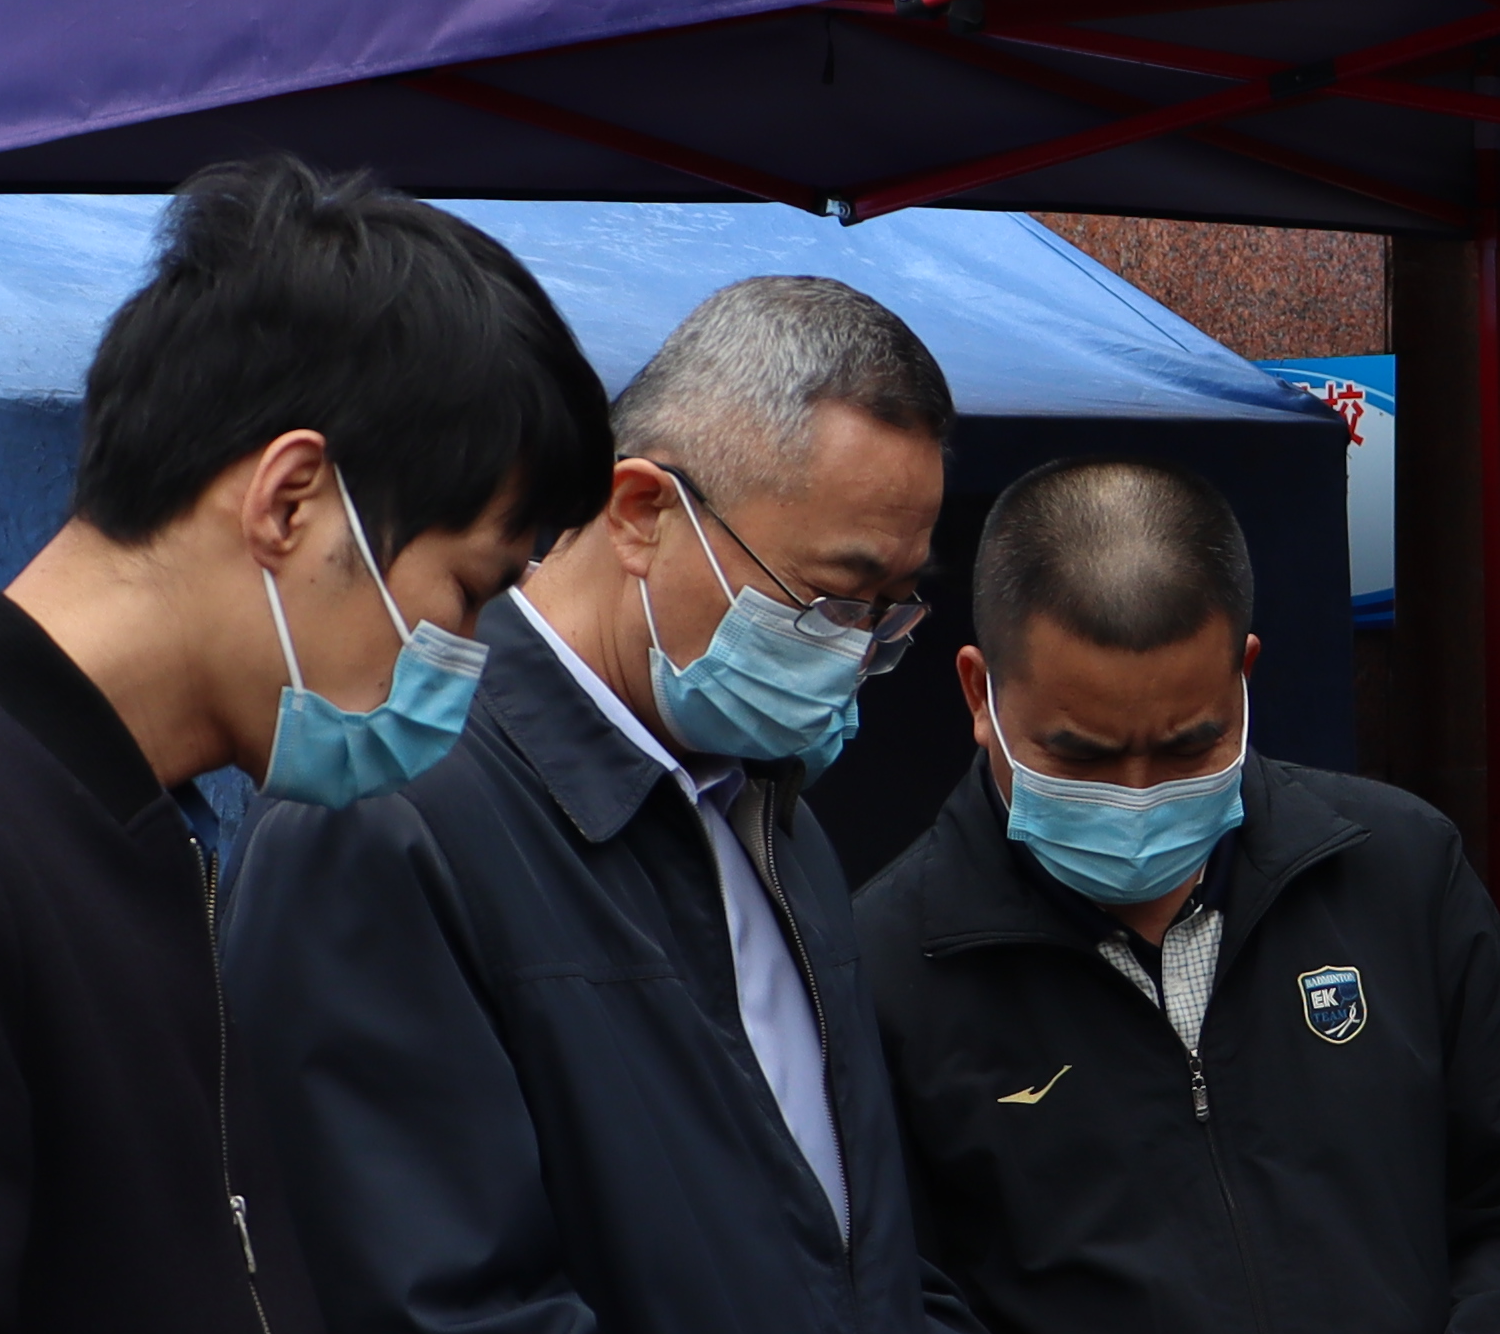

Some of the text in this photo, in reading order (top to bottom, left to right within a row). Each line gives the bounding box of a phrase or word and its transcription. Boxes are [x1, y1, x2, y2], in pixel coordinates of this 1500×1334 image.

[1304, 972, 1357, 988] BADMINTON
[1310, 987, 1340, 1009] EK
[1313, 1009, 1348, 1023] TEAM
